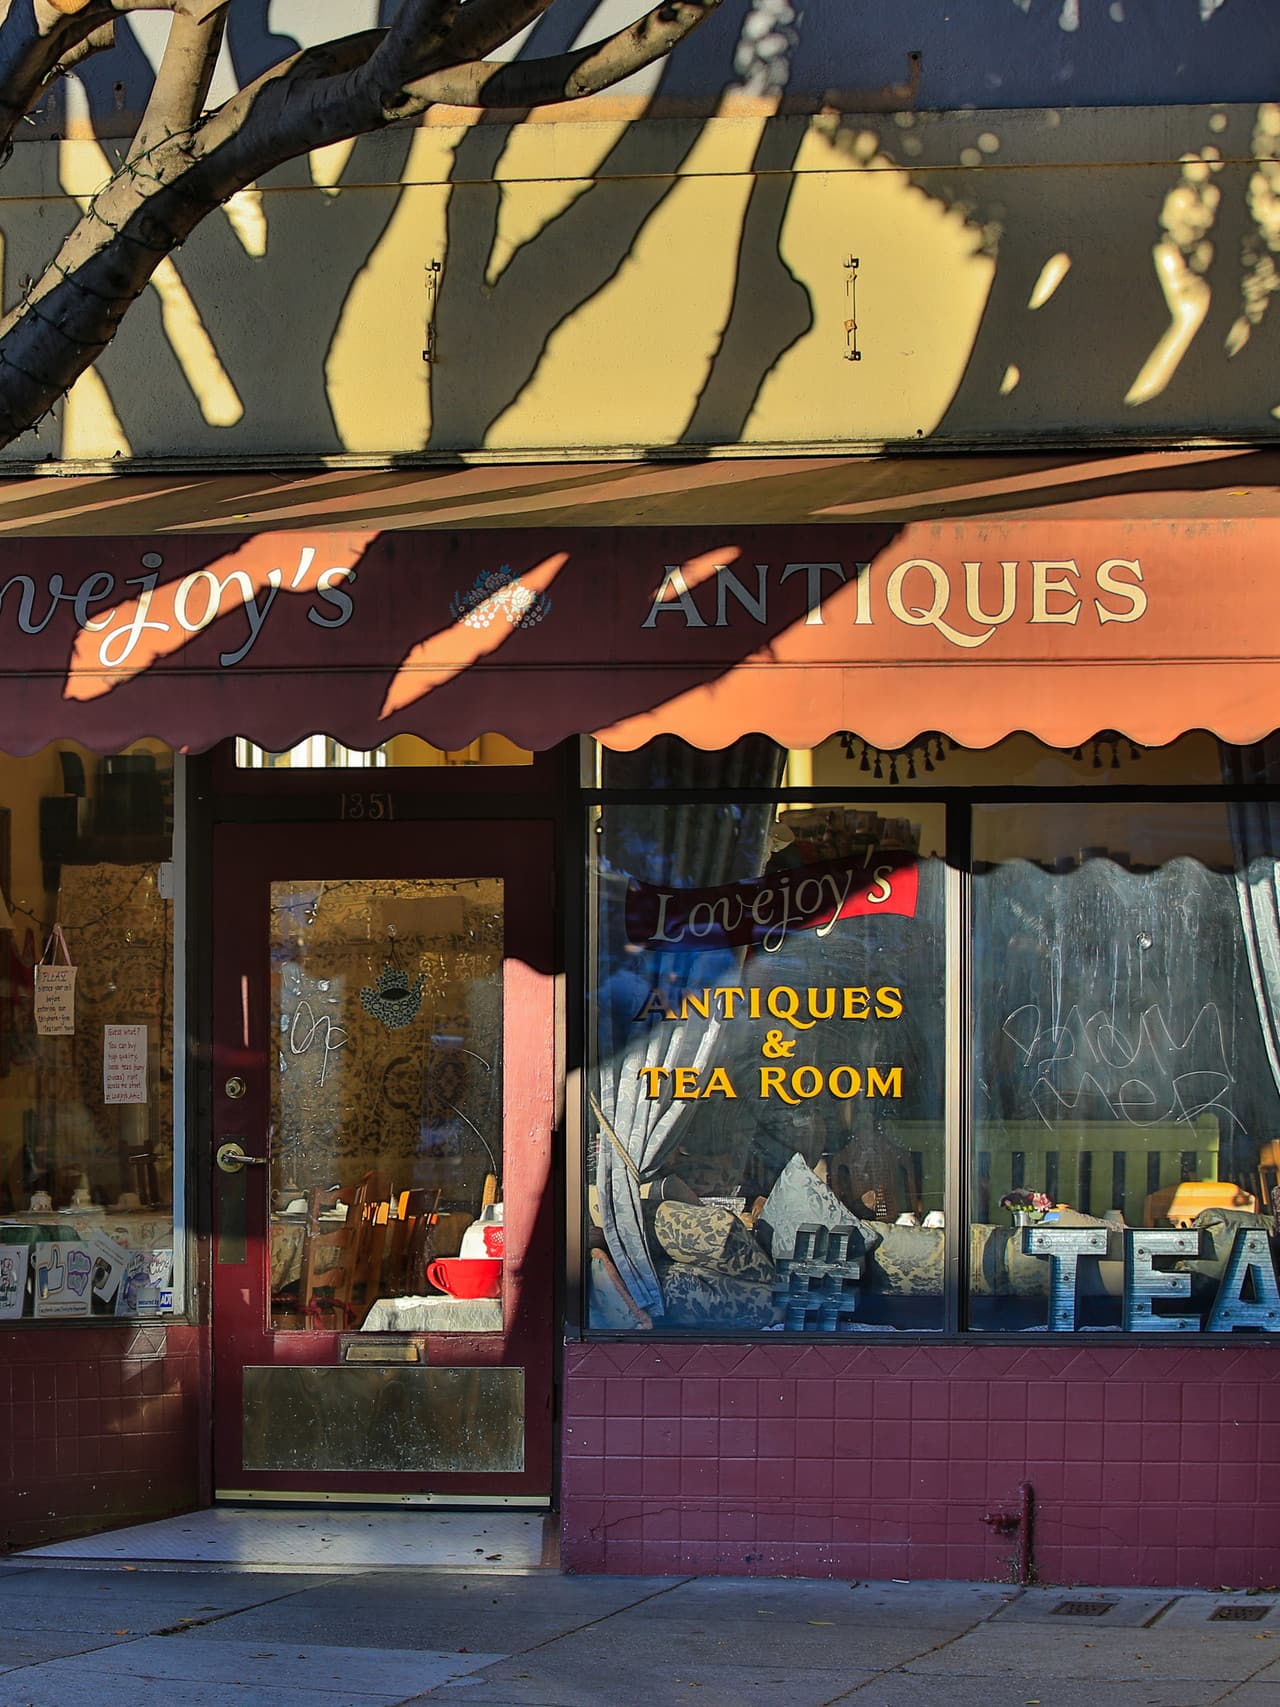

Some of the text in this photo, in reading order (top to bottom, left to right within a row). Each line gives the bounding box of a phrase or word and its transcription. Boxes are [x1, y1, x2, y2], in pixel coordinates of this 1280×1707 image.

[640, 557, 1149, 649] ANTIQUES
[338, 793, 393, 820] 1351
[648, 844, 893, 952] Lovejoy's
[372, 991, 422, 1012] CLOSED
[635, 985, 903, 1030] ANTIQUES
[761, 1029, 796, 1058] &
[638, 1066, 904, 1105] TEA ROOM
[160, 1293, 173, 1305] ADT
[1021, 1227, 1280, 1332] TEA
